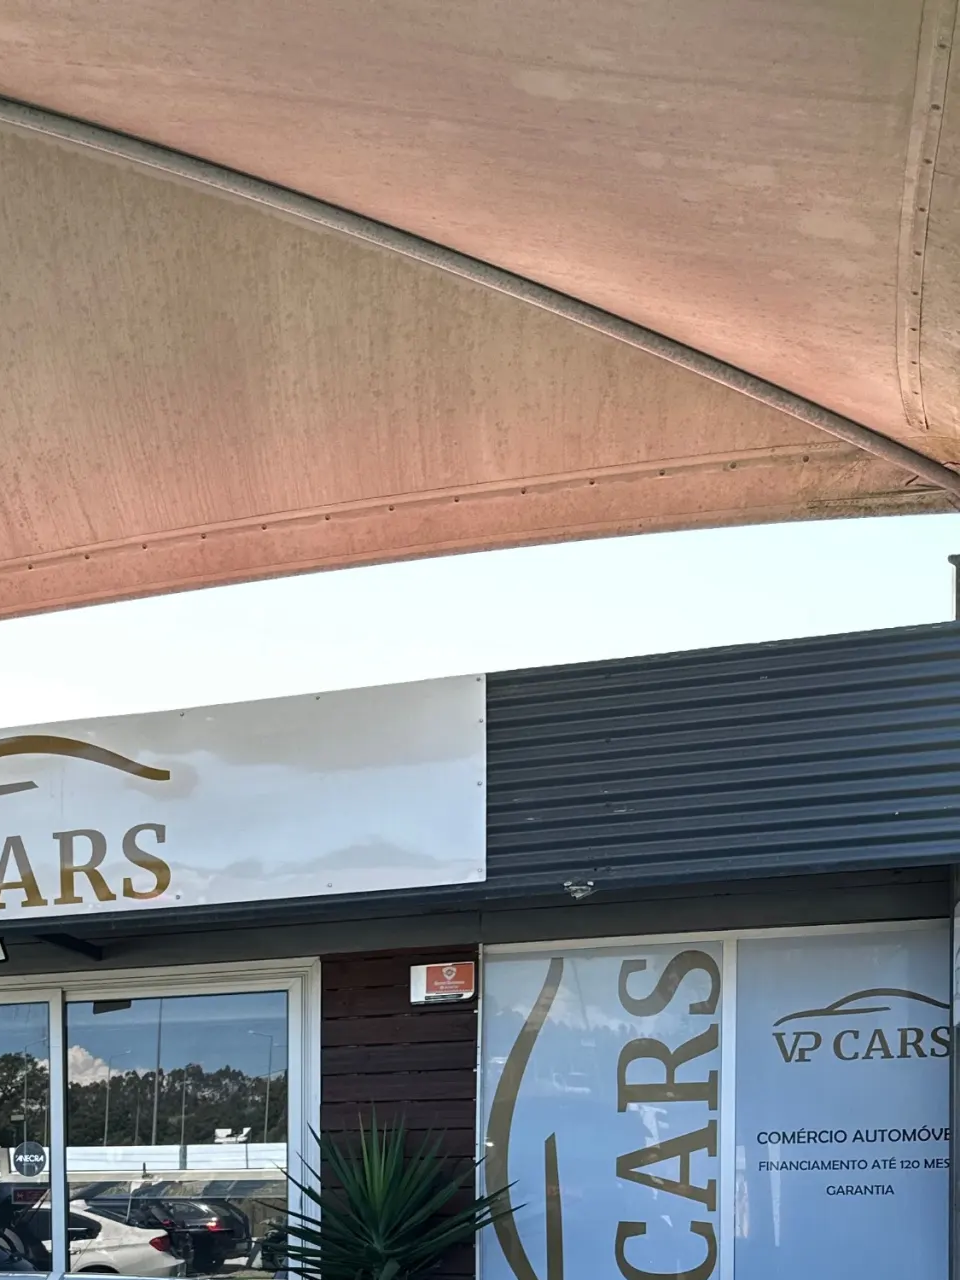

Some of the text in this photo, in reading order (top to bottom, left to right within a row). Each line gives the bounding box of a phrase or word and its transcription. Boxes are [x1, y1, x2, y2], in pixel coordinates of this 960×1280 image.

[772, 1026, 950, 1063] VP CARS
[757, 1128, 847, 1145] COMÉRCIO
[758, 1158, 868, 1172] FINANCIAMENTO
[871, 1157, 897, 1170] ATÉ
[900, 1159, 920, 1169] 120
[826, 1184, 895, 1196] GARANTIA
